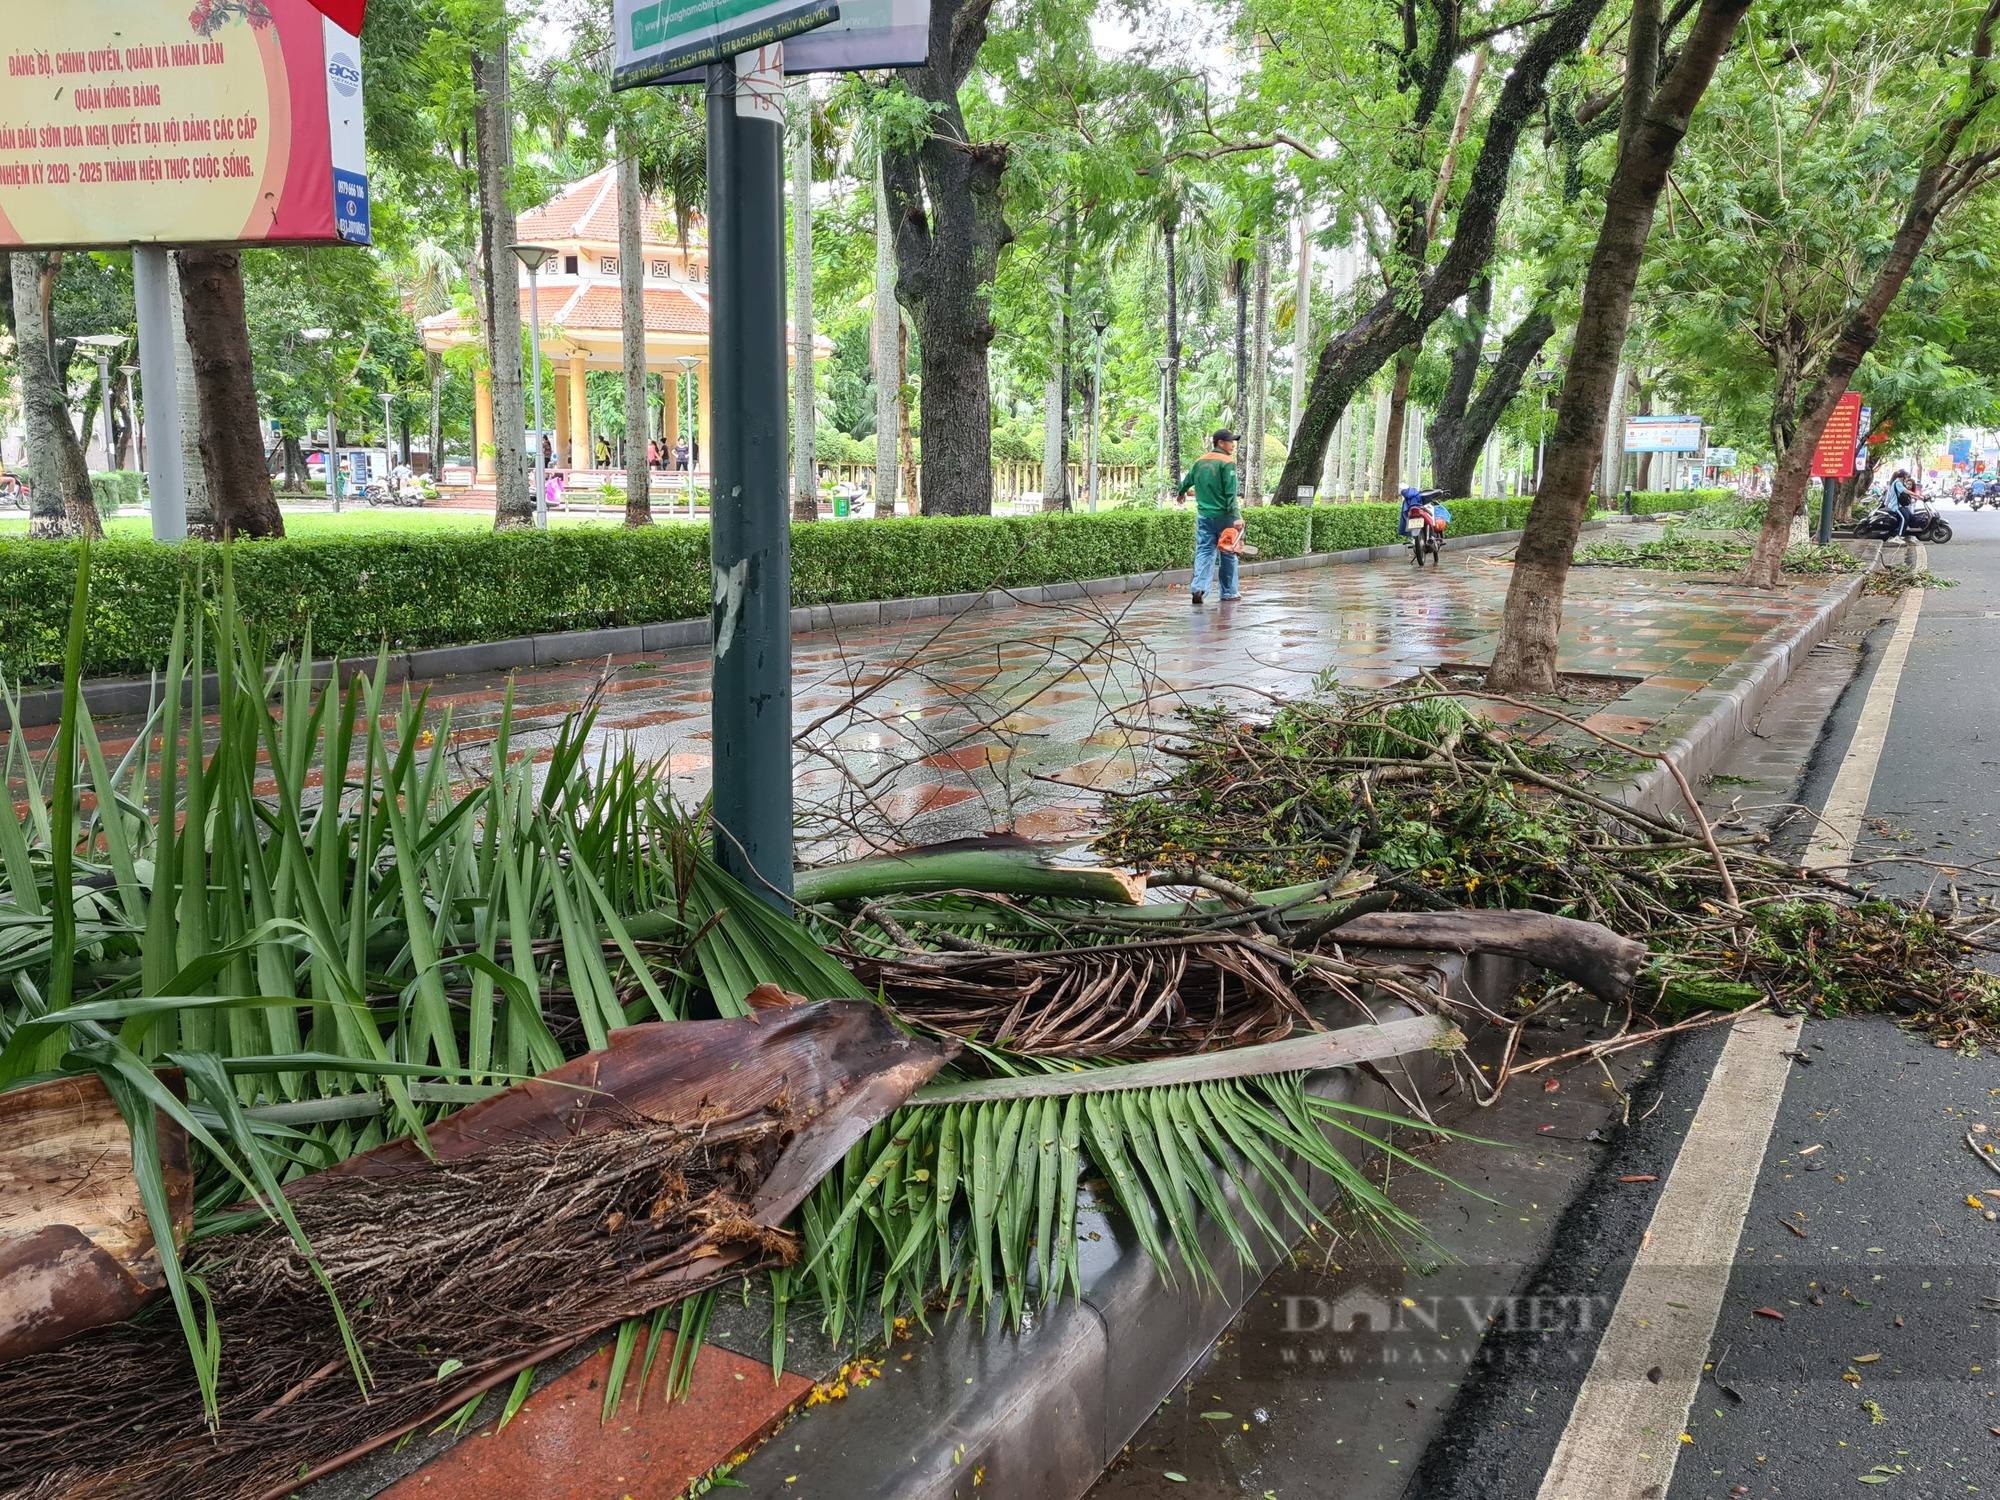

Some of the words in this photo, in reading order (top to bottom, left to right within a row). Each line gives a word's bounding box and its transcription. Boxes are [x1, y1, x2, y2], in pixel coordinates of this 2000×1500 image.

[8, 48, 35, 76] ĐẢNG
[37, 49, 54, 79] BỘ,
[56, 47, 86, 74] CHÍNH
[88, 42, 124, 74] QUYỀN,
[125, 43, 153, 72] QUÂN
[155, 41, 169, 68] VÀ
[171, 39, 200, 67] NHÂN
[202, 38, 224, 65] DÂN
[628, 70, 639, 82] 258
[669, 58, 678, 69] 72
[697, 46, 715, 60] TRAY
[721, 41, 730, 53] 67
[74, 83, 101, 114] QUẬN
[103, 80, 131, 108] HỒNG
[133, 80, 161, 107] BÀNG
[18, 120, 37, 149] ĐẤU
[39, 122, 61, 148] SỚM
[63, 124, 84, 147] ĐƯA
[85, 124, 110, 151] NGHỊ
[111, 116, 141, 147] QUYẾT
[144, 122, 161, 148] ĐẠI
[163, 116, 181, 147] HỘI
[182, 113, 211, 142] ĐẢNG
[213, 114, 234, 141] CÁC
[237, 109, 257, 140] CẤP
[0, 160, 30, 189] NHIỆM
[32, 159, 44, 185] KỲ
[46, 163, 70, 183] 2020
[79, 162, 102, 183] 2025
[104, 156, 137, 182] THÀNH
[138, 155, 163, 185] HIỆN
[165, 156, 190, 184] THỰC
[192, 152, 220, 184] CUỘC
[222, 148, 254, 178] SỐNG.
